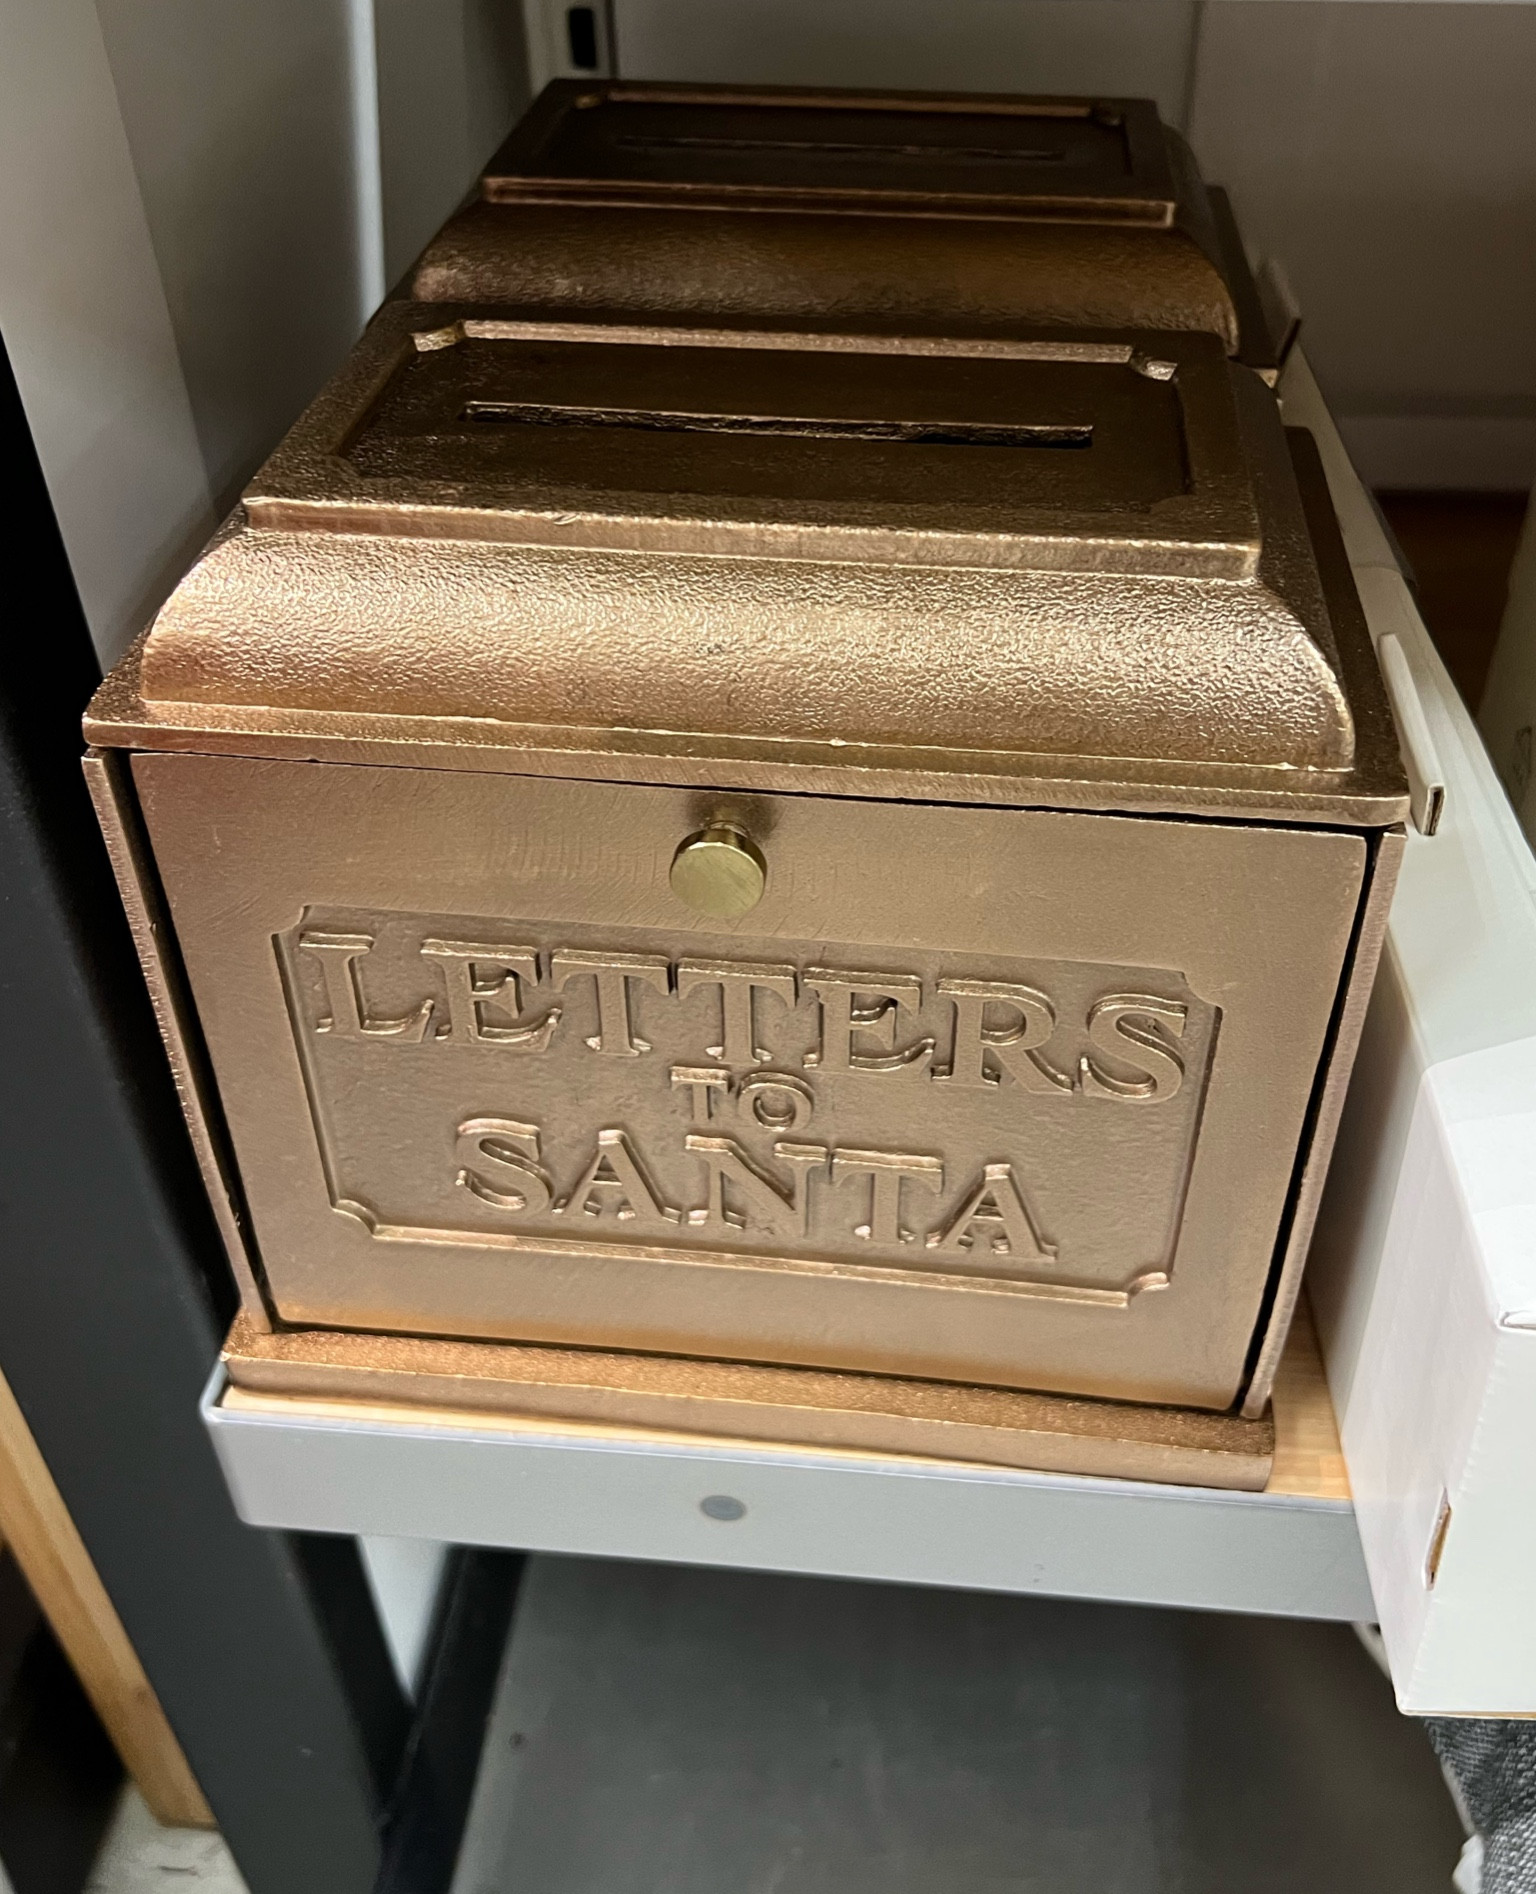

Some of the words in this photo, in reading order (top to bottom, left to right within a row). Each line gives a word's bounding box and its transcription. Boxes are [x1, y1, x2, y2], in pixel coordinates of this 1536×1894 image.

[299, 931, 1187, 1104] LETTERS
[669, 1064, 815, 1132] TO
[455, 1116, 1058, 1262] SANTA
